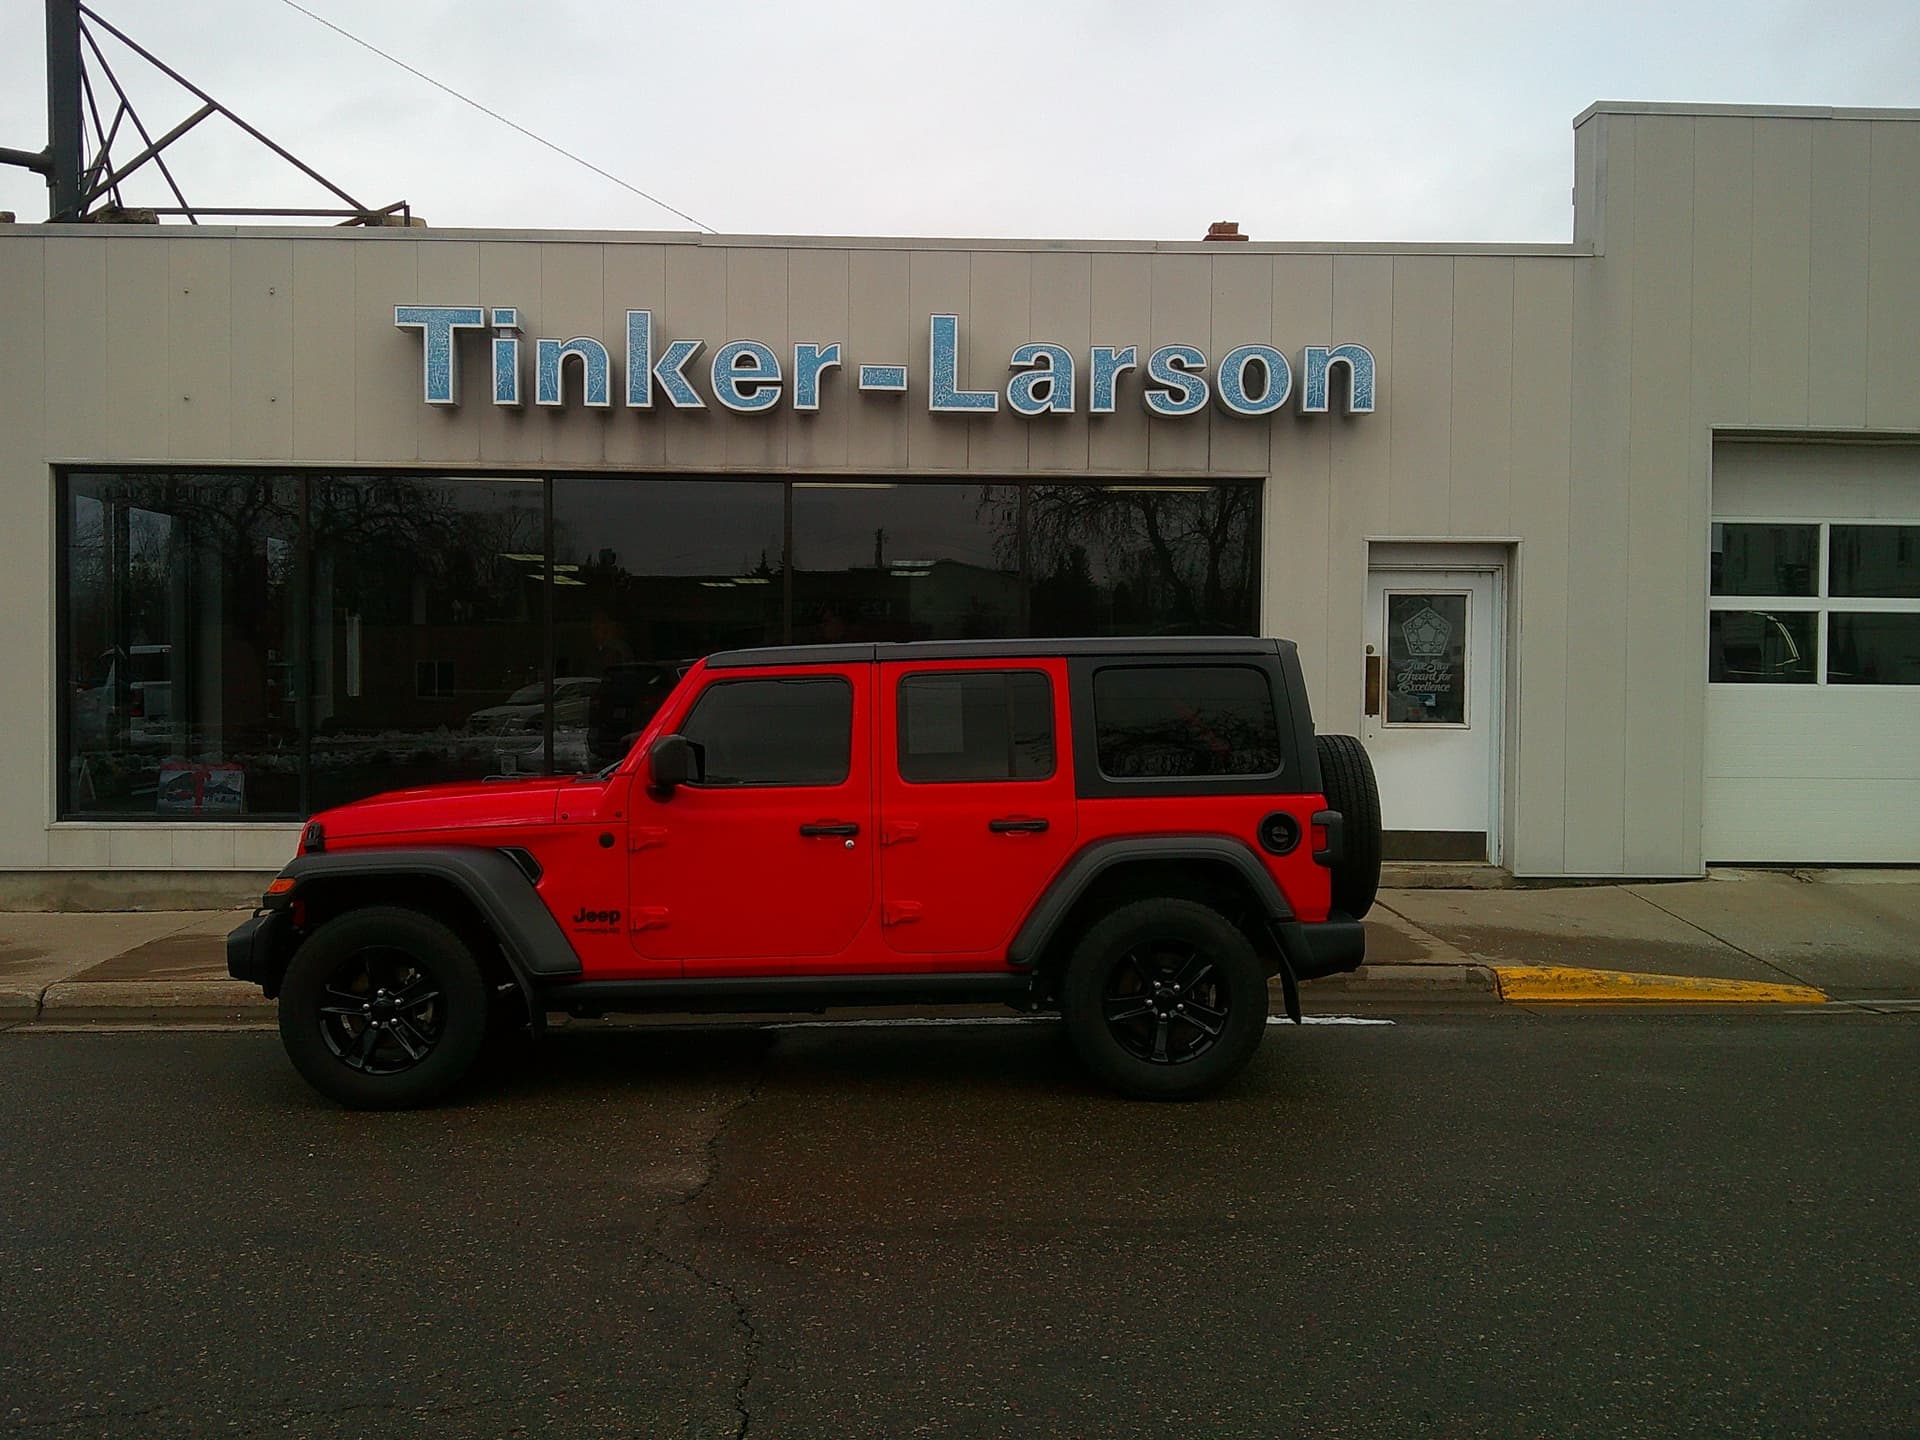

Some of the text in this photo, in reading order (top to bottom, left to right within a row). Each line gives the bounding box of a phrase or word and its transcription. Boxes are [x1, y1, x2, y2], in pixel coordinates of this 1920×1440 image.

[393, 305, 1376, 416] Tinker-Larson
[1397, 671, 1453, 683] Award for
[1397, 681, 1451, 694] Excellence
[573, 907, 621, 925] Jeep
